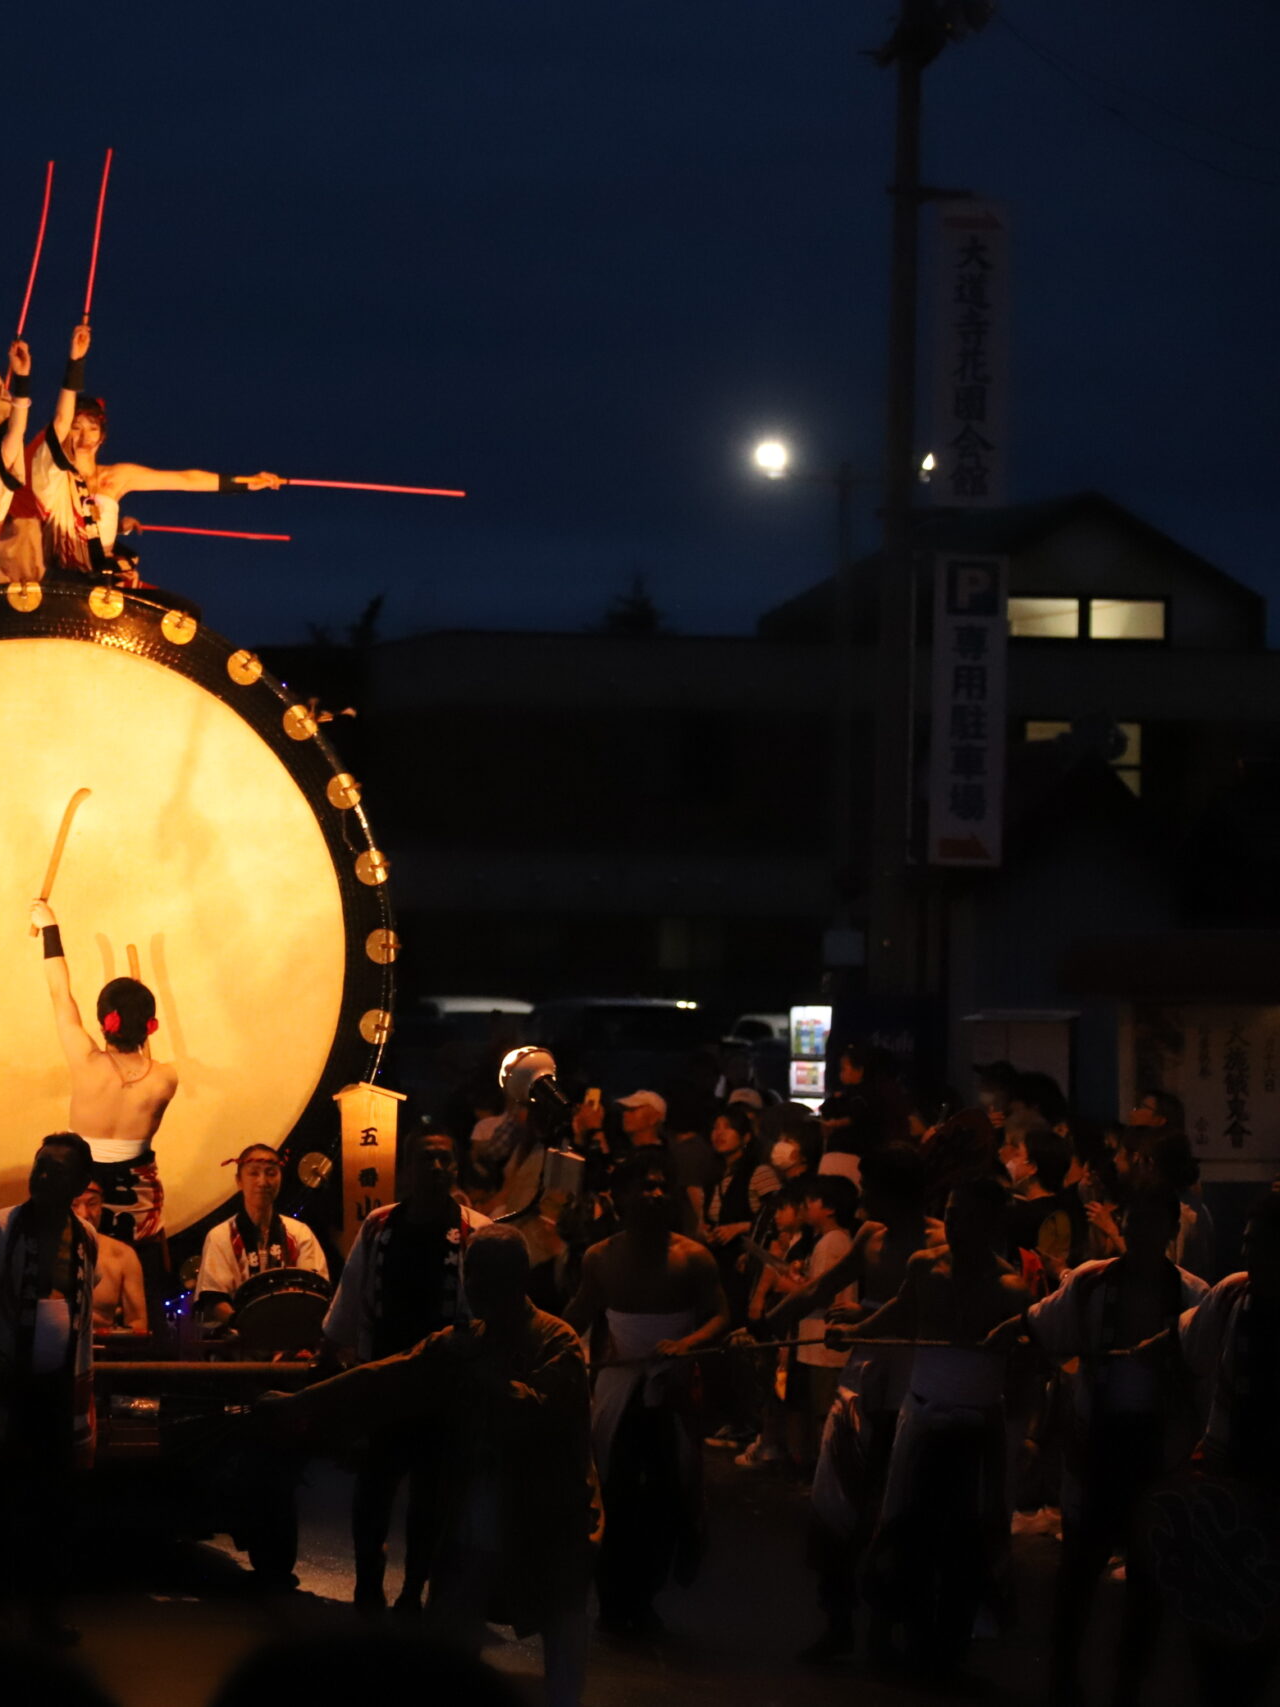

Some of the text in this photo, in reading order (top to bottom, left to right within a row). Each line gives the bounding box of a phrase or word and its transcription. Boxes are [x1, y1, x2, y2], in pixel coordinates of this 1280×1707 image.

[956, 566, 991, 609] P
[948, 625, 988, 822] 専用駐車場
